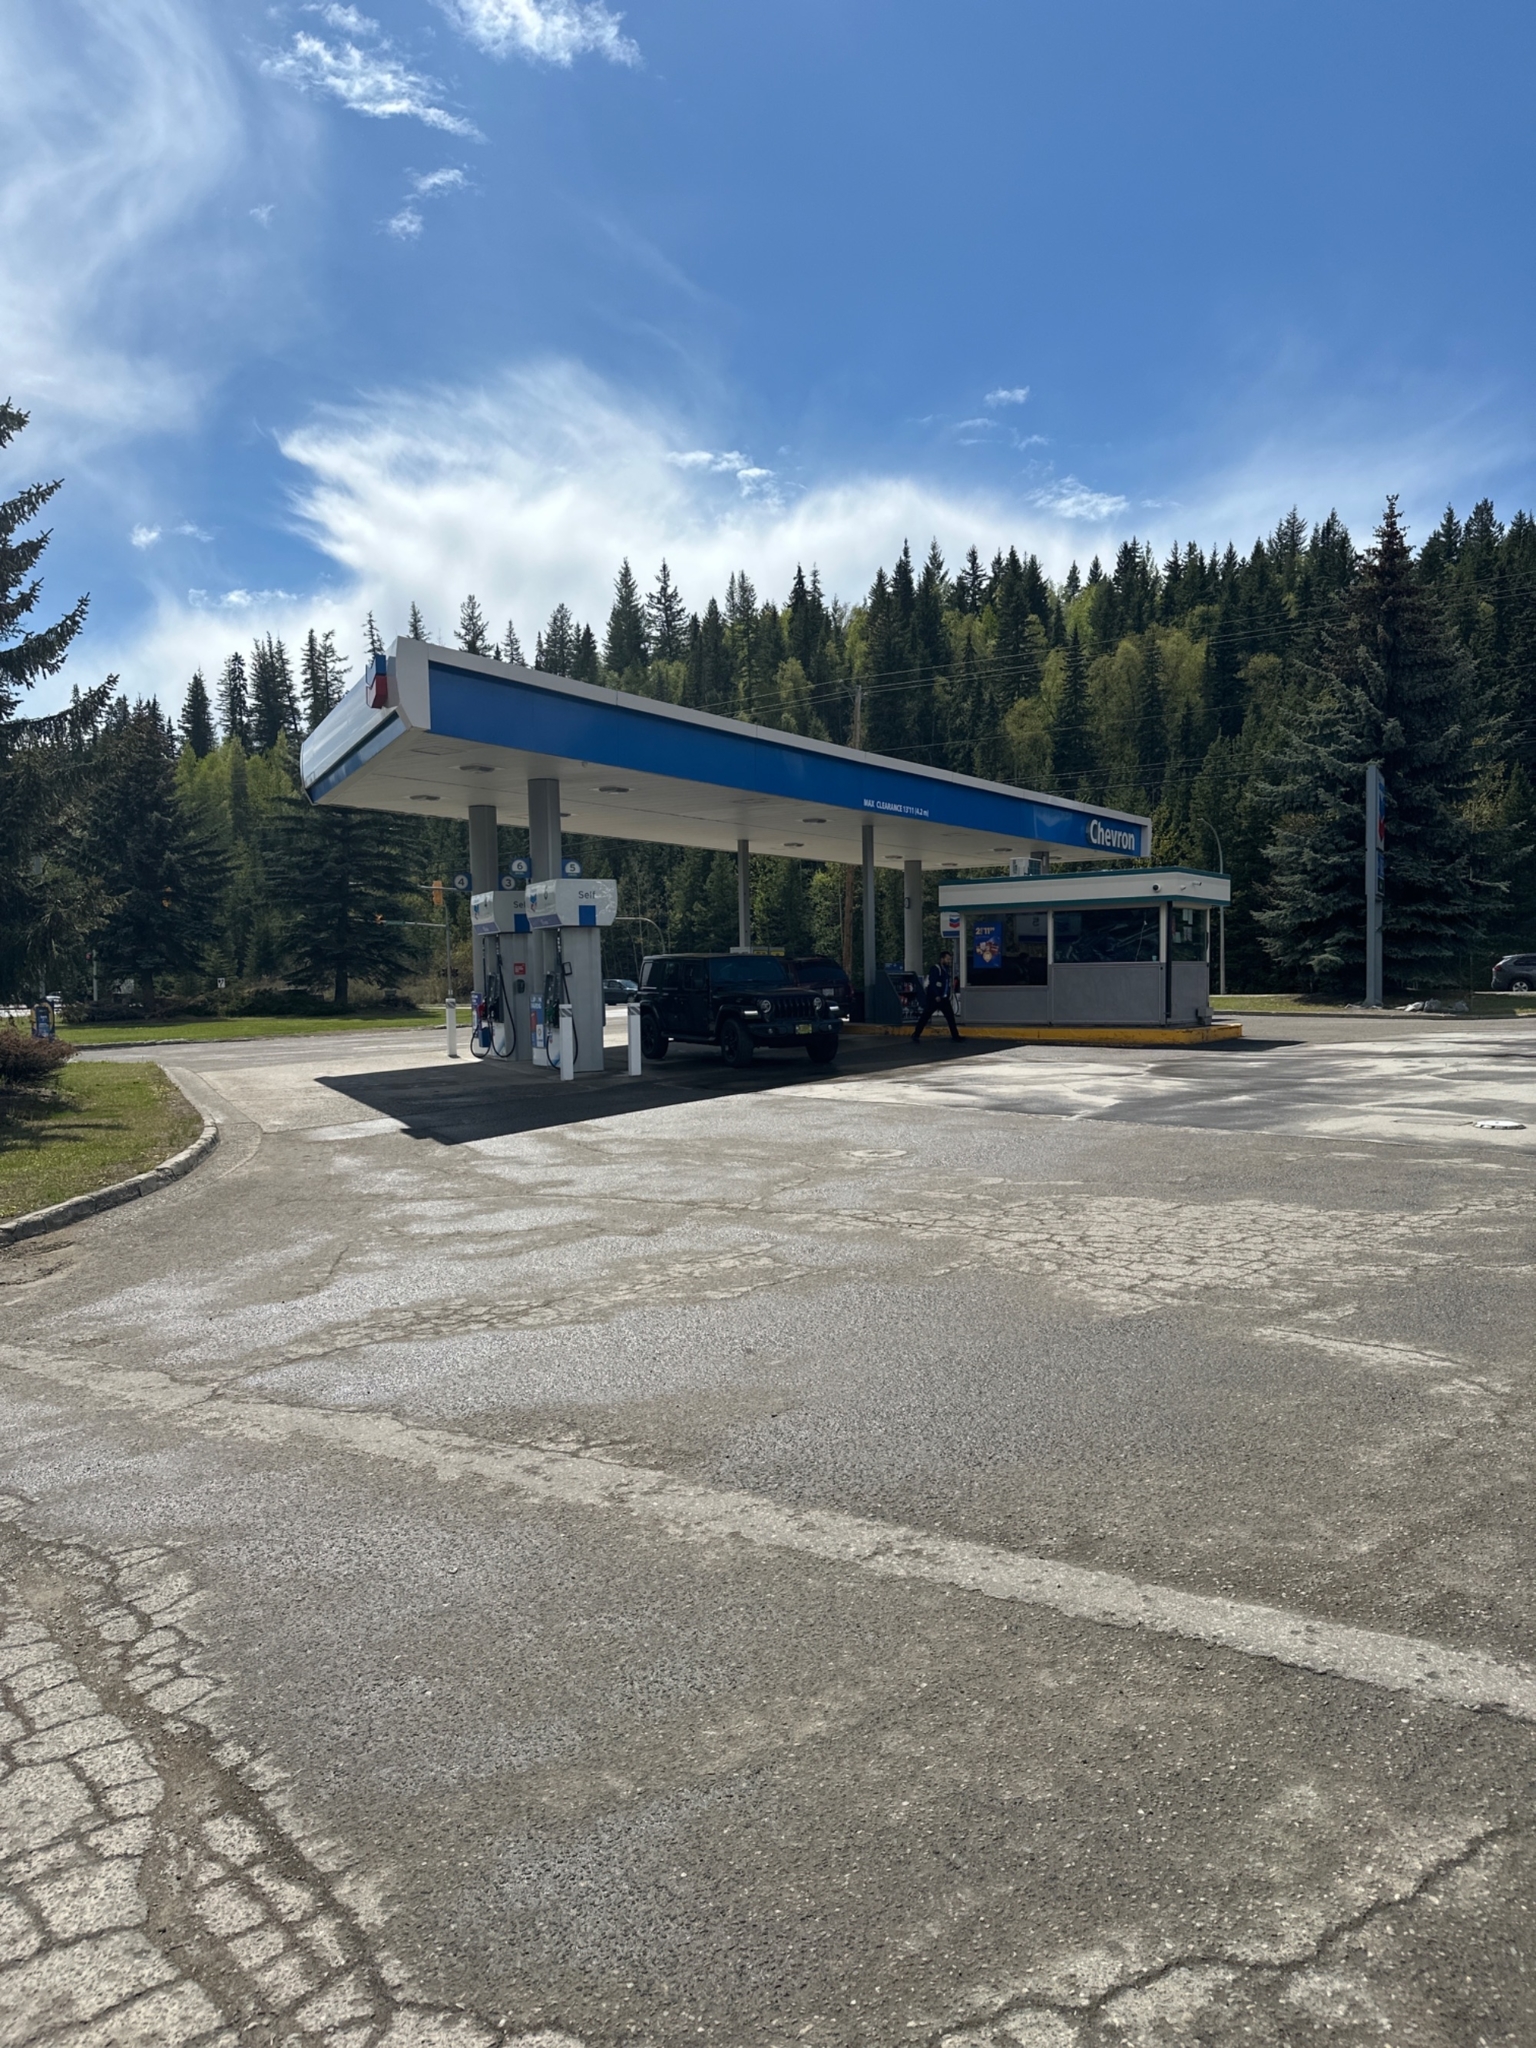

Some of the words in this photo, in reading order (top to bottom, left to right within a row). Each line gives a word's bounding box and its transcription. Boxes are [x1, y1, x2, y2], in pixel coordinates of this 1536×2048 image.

[863, 798, 875, 808] MAX
[876, 801, 903, 813] CLEARANCE
[1090, 819, 1135, 851] Chevron
[516, 861, 524, 870] 6
[569, 863, 576, 872] 5
[458, 878, 465, 886] 4
[506, 878, 512, 887] 3
[578, 890, 596, 900] Self
[513, 900, 525, 909] Sel
